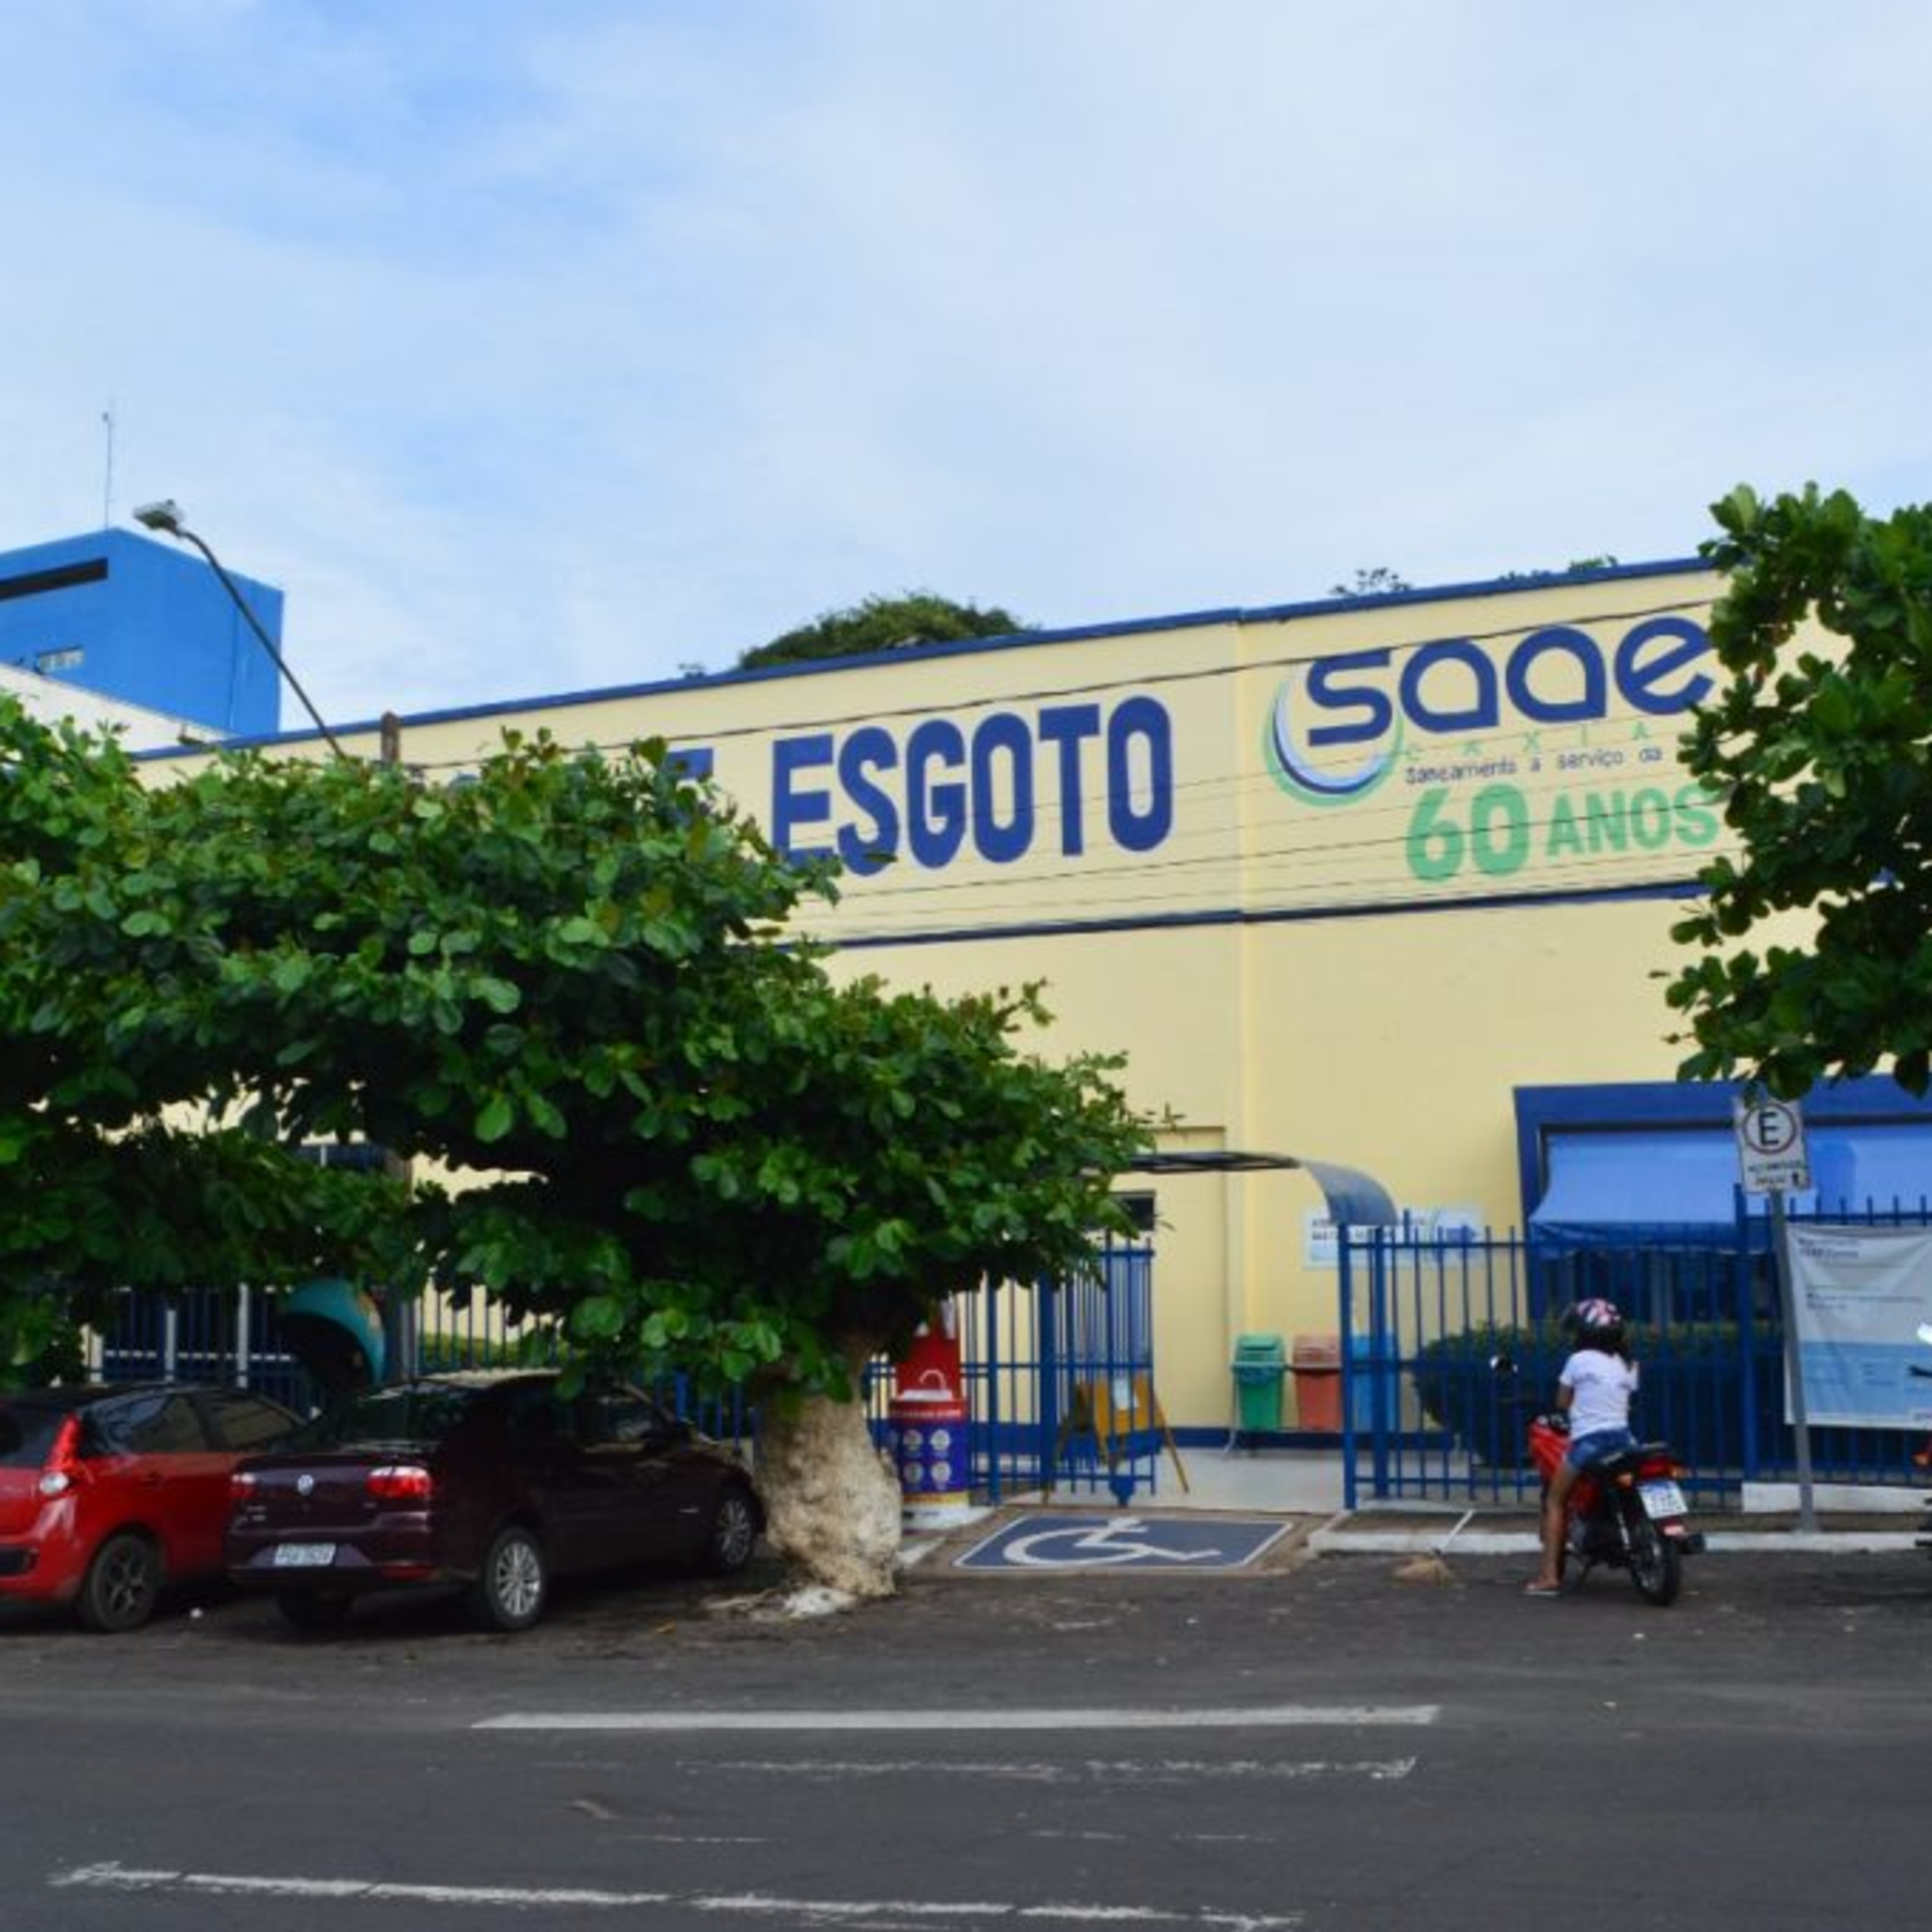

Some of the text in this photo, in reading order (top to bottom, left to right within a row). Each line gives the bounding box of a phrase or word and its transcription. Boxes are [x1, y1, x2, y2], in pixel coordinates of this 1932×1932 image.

[1306, 616, 1716, 746] saae
[772, 696, 1172, 875] ESGOTO
[1405, 781, 1720, 883] 60 ANOS
[1759, 1112, 1779, 1146] E
